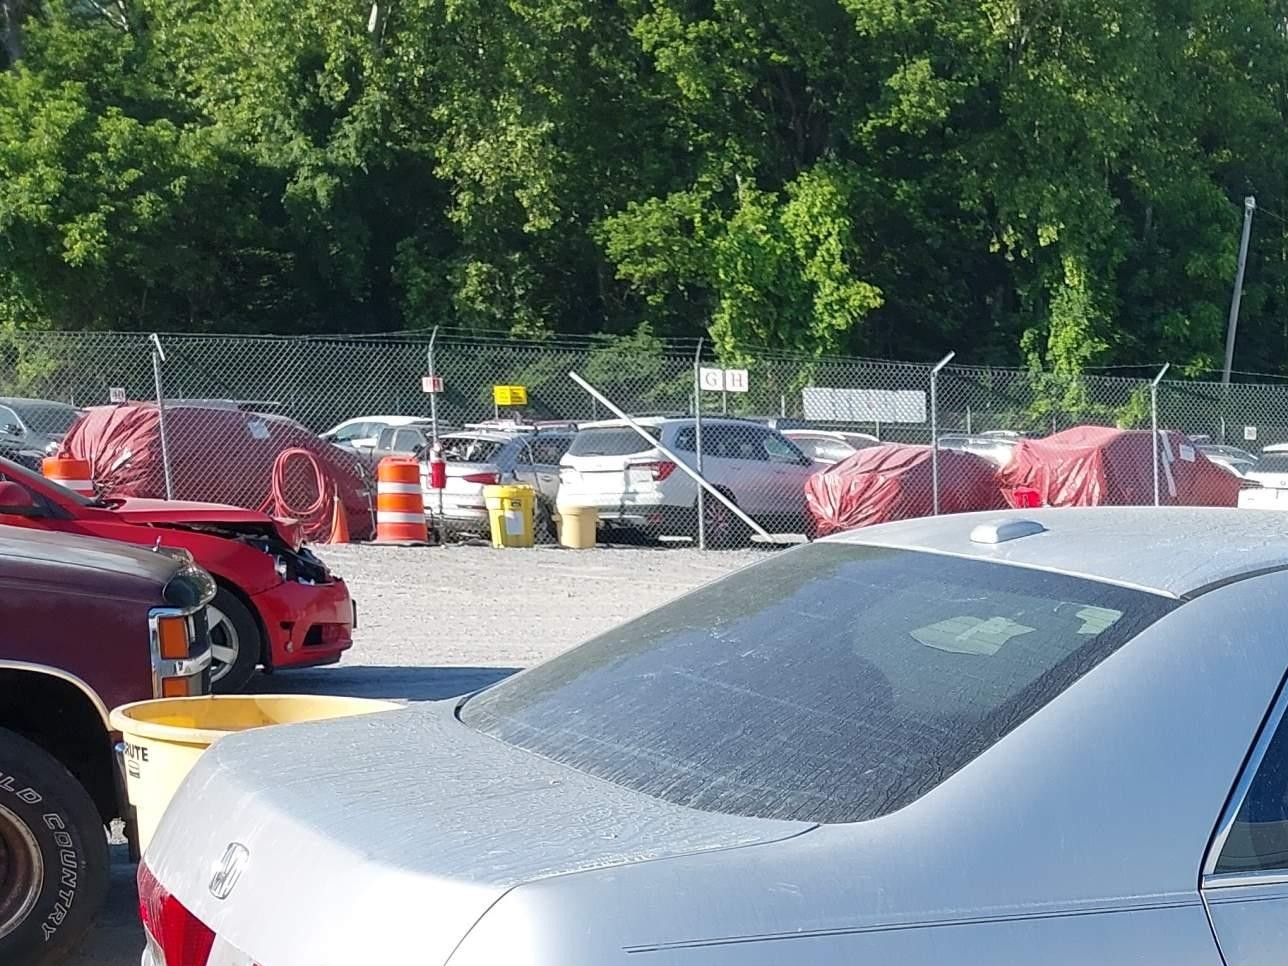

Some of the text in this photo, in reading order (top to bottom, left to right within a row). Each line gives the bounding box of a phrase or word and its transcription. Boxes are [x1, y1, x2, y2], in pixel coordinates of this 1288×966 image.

[705, 371, 718, 387] G
[731, 372, 743, 388] H
[124, 742, 149, 762] RUTE
[0, 772, 78, 942] LD COUNTRY
